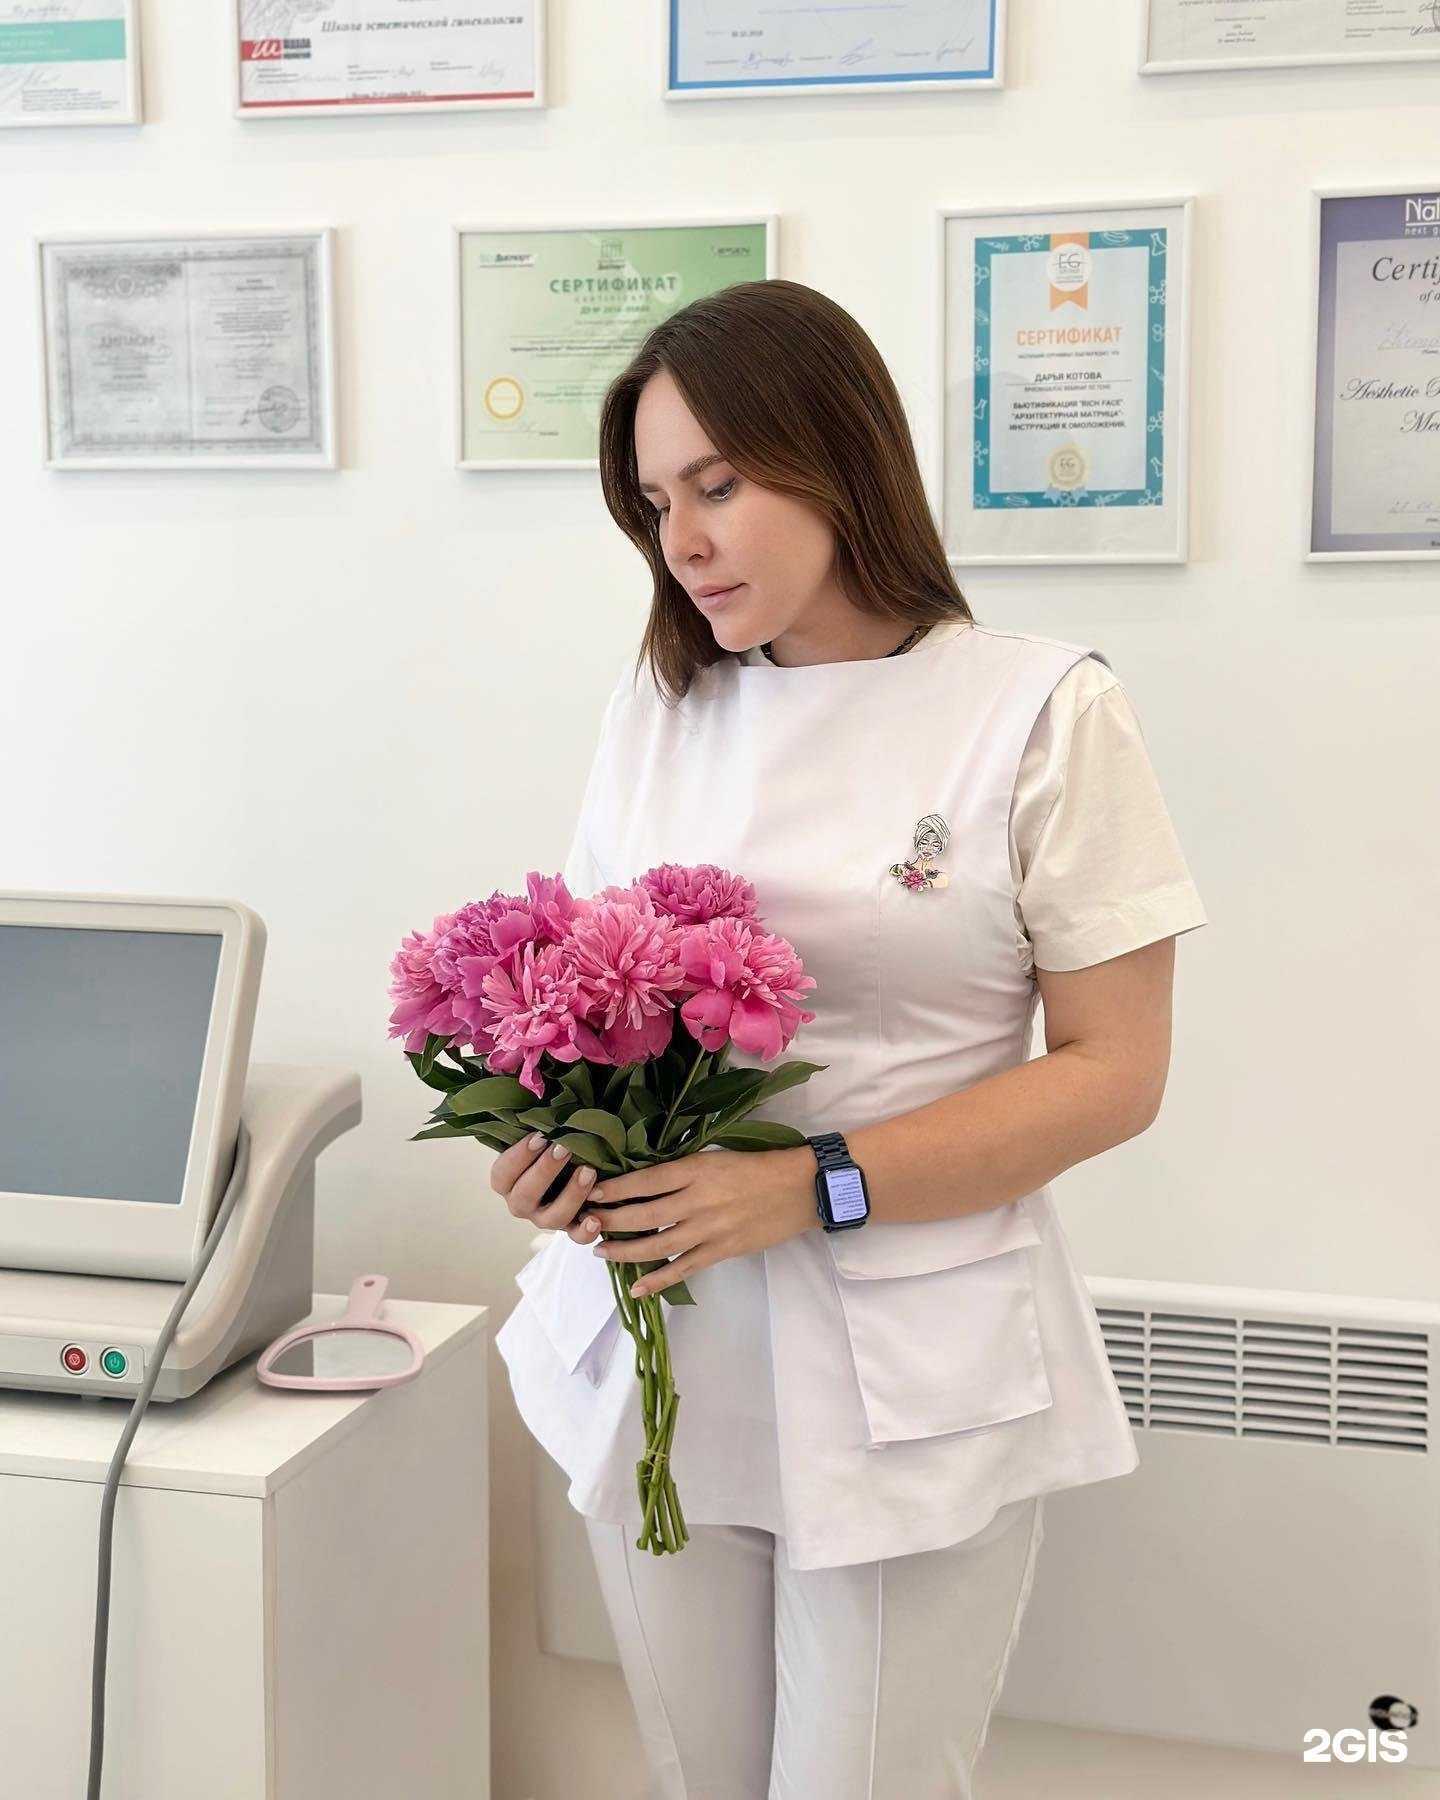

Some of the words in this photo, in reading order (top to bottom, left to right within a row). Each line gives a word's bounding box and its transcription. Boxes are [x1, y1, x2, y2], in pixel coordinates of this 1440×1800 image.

[321, 20, 362, 33] Школа
[365, 16, 449, 30] эстетической
[549, 275, 677, 294] СЕРТИФИКАТ
[1419, 289, 1434, 304] of
[1016, 326, 1122, 346] СЕРТИФИКАТ
[1034, 373, 1065, 383] ДАРЬЯ
[1066, 371, 1102, 381] КОТОВА
[1340, 377, 1420, 401] Aesthetic
